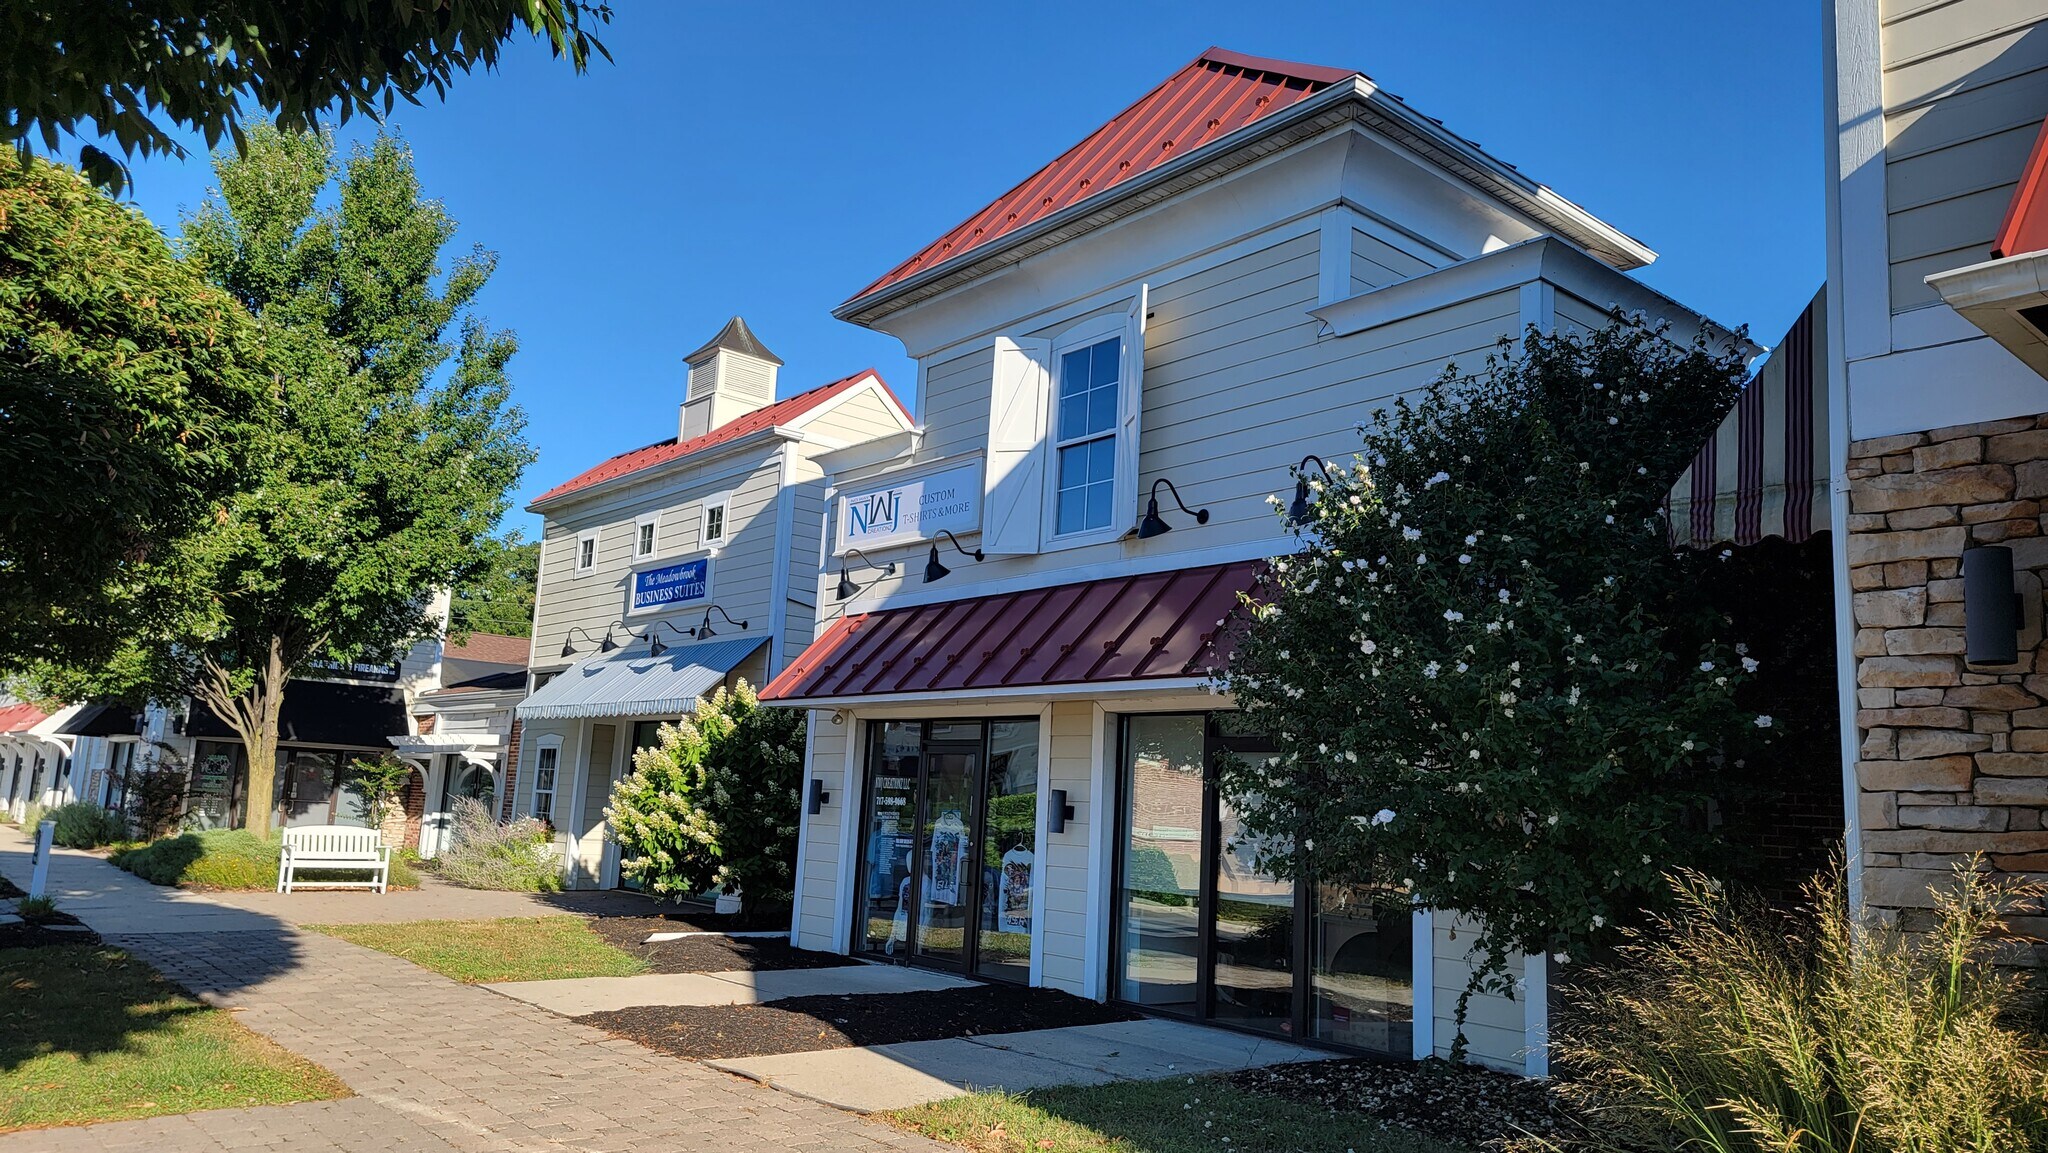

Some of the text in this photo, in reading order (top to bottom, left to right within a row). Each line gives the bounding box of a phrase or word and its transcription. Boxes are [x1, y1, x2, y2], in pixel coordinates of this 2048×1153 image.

[919, 488, 955, 505] CUSTOM
[645, 573, 655, 587] The
[635, 581, 704, 605] BUSINESS SUITES
